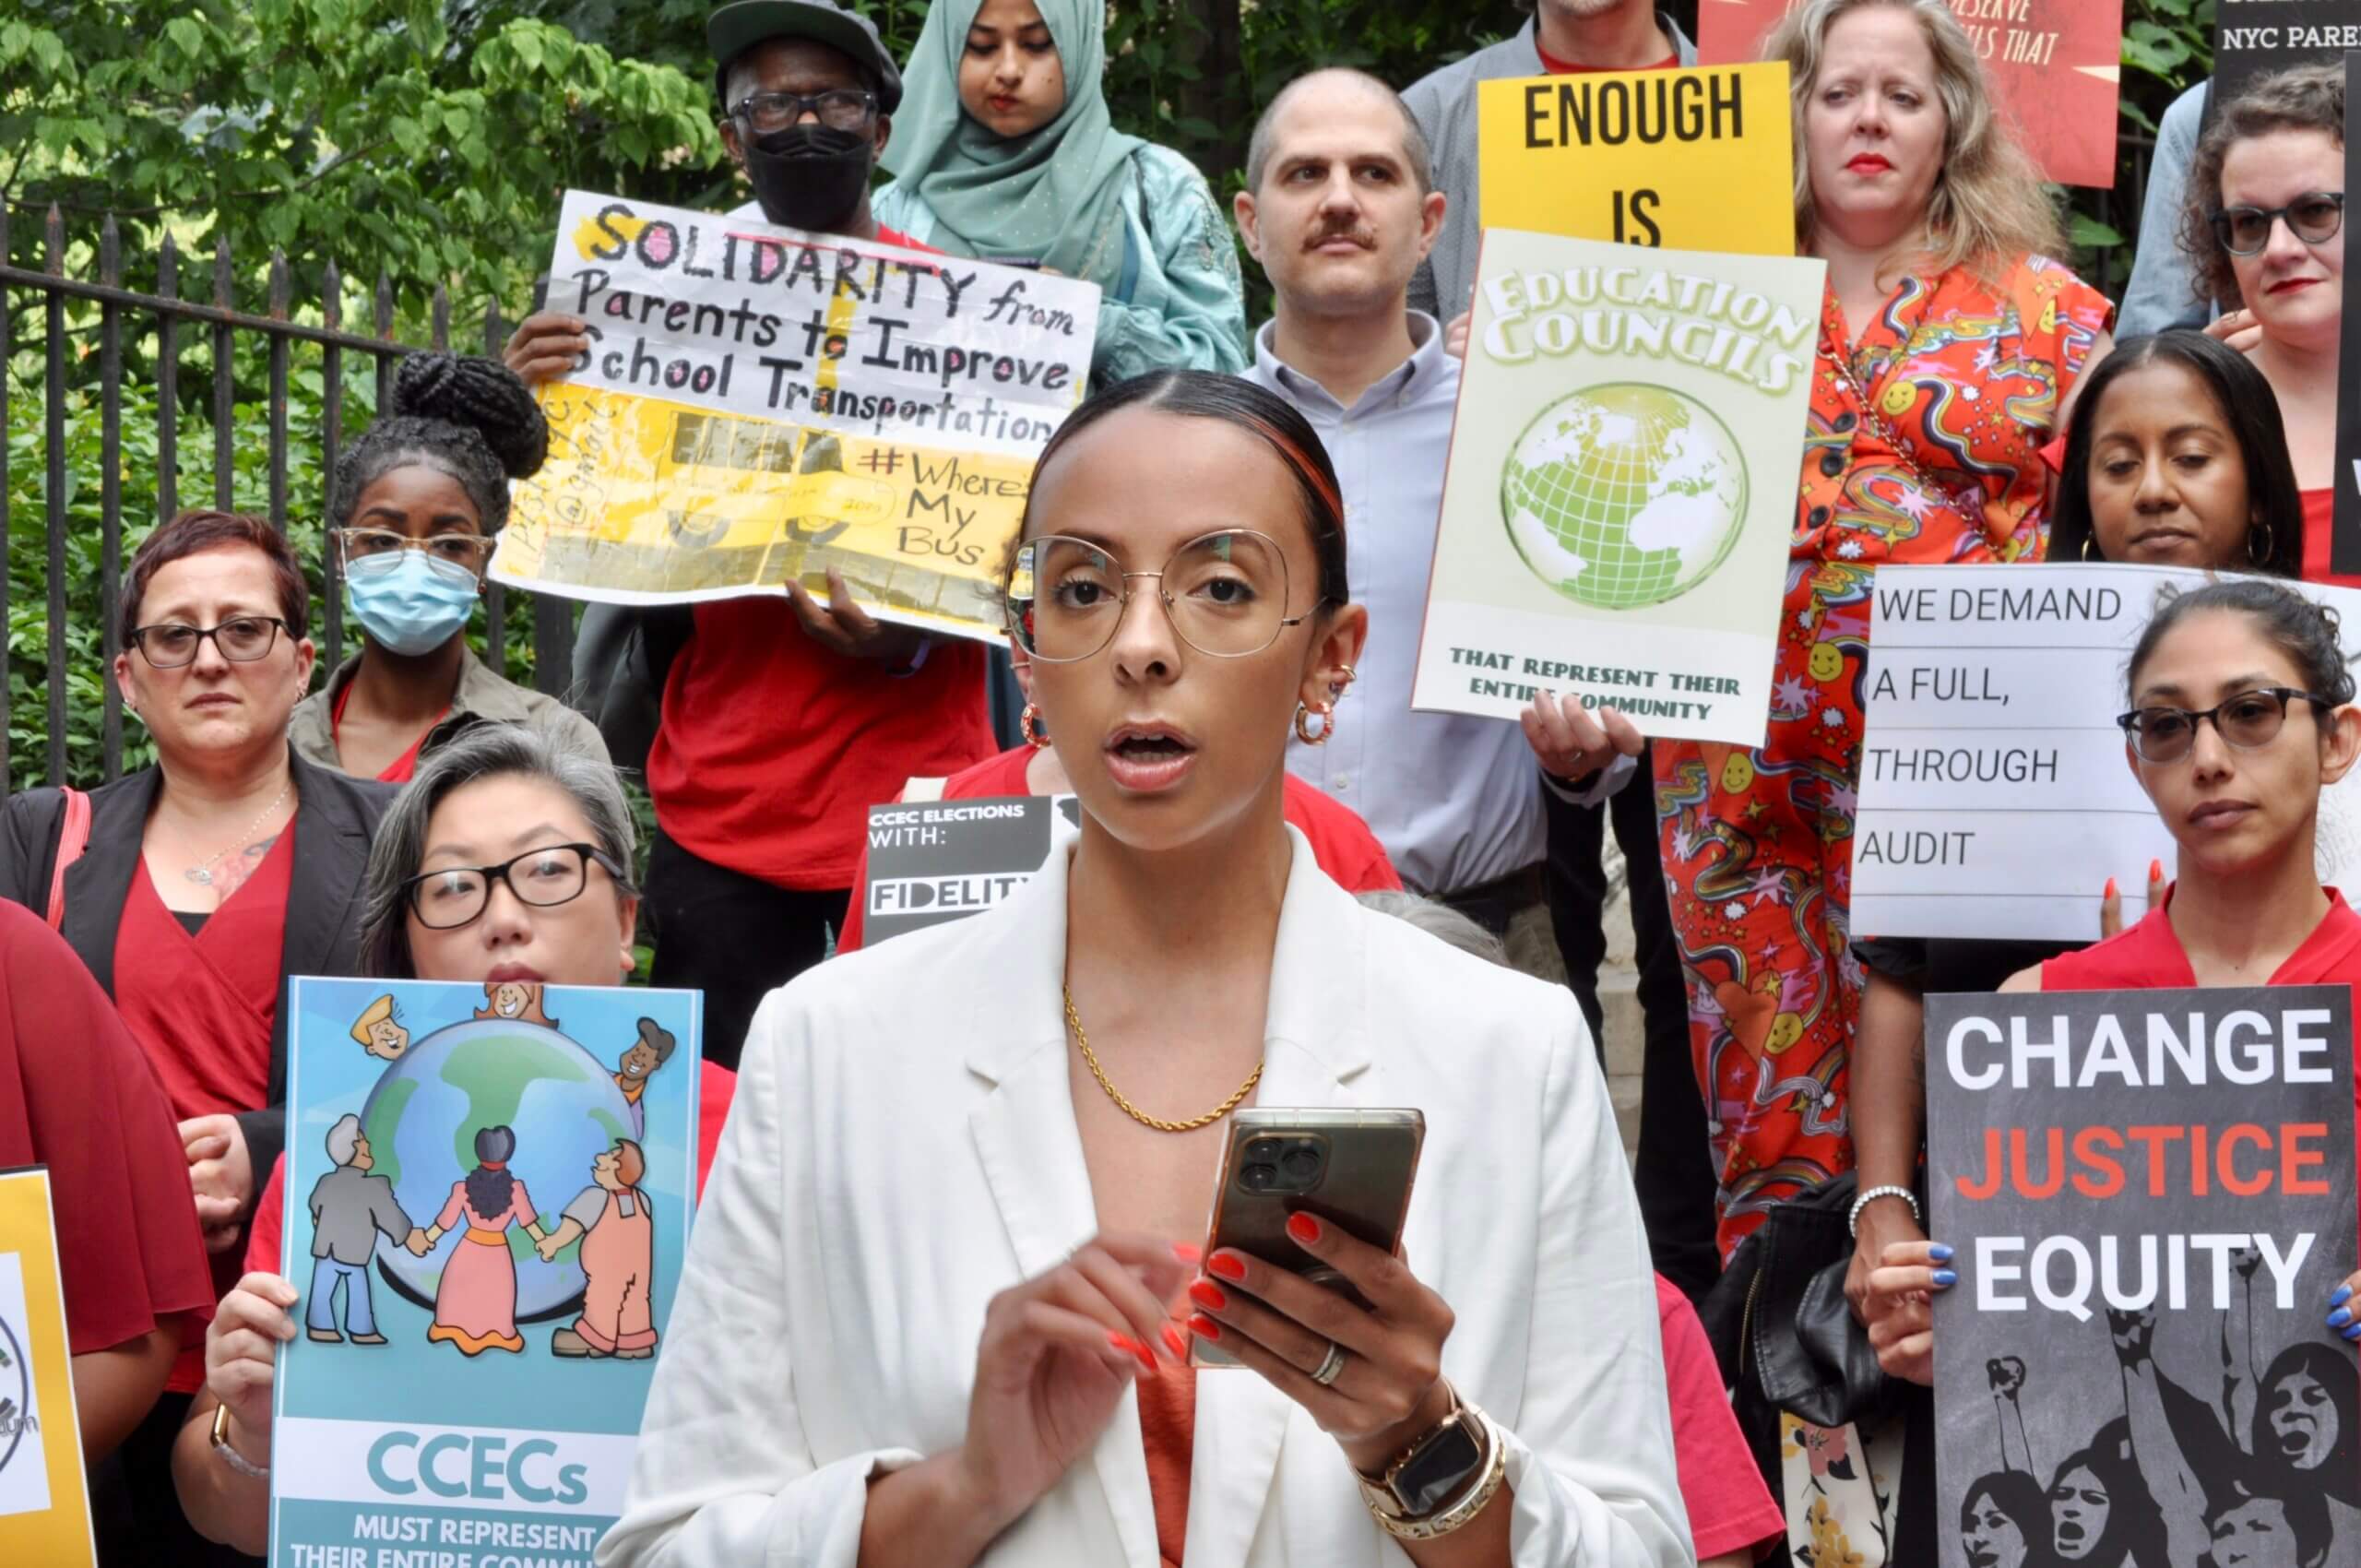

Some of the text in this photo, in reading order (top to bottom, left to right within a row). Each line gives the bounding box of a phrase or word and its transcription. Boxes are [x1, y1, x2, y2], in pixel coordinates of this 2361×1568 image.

[1952, 0, 2030, 22] ESERVE
[2003, 29, 2058, 65] THAT
[2223, 26, 2361, 50] NYC PARE
[1525, 73, 1743, 148] ENOUGH
[1612, 189, 1661, 248] IS
[590, 204, 1074, 335] SOLIDARITY from
[1482, 267, 1811, 350] EDUCATION
[572, 268, 1070, 389] Parents to Improve
[567, 325, 734, 397] School
[1482, 308, 1805, 397] COUNCILS
[906, 488, 977, 541] My
[896, 526, 985, 565] Bus
[1879, 588, 2121, 622] WE DEMAND
[1449, 647, 1741, 695] THAT REPRESENT THEIR
[1872, 668, 2010, 706] A FULL,
[1572, 692, 1713, 719] OMMUNITY
[1869, 749, 2058, 782] THROUGH
[869, 804, 1025, 826] CCEC ELECTIONS
[869, 826, 947, 848] WITH:
[1858, 831, 1975, 865] AUDIT
[873, 876, 1028, 909] FIDELIT
[1946, 1009, 2333, 1089] CHANGE
[1956, 1123, 2330, 1199] JUSTICE
[1975, 1233, 2317, 1323] EQUITY
[367, 1430, 588, 1505] CCECs
[353, 1515, 597, 1551] MUST REPRESENT
[291, 1544, 368, 1568] THEIR
[377, 1550, 472, 1568] ENTIRE
